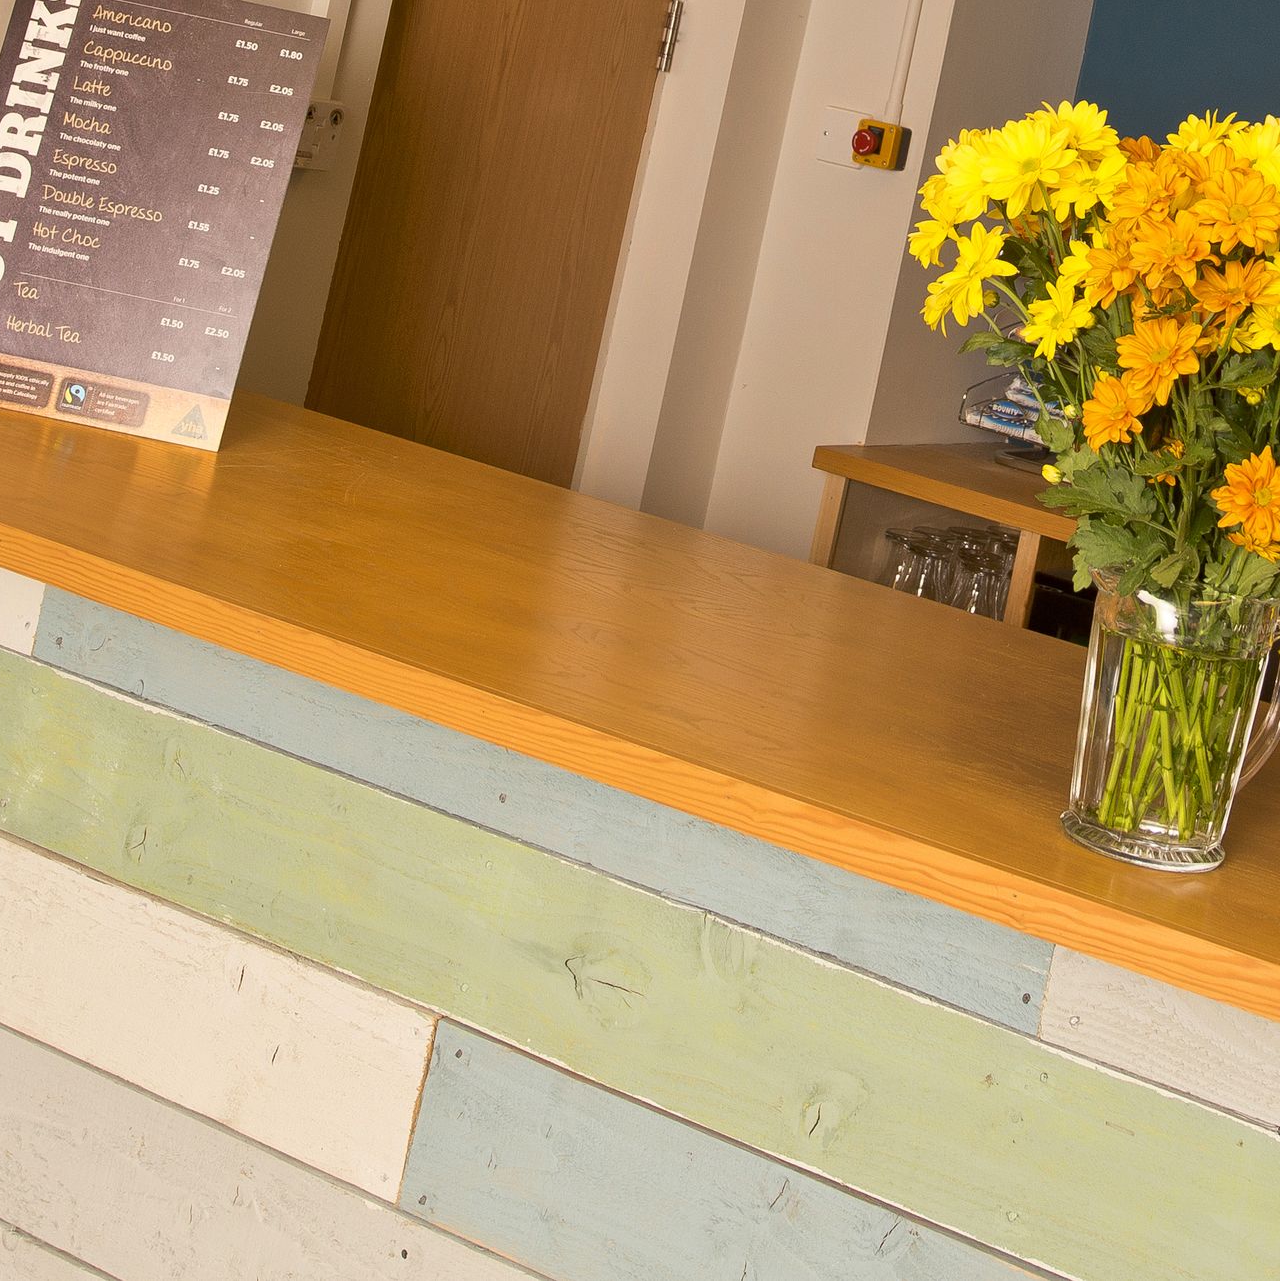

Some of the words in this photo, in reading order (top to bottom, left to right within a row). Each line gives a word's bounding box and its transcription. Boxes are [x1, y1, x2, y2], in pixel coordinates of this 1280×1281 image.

[92, 4, 172, 33] Americano
[235, 39, 259, 51] £1.50
[280, 49, 303, 61] £1.80
[92, 25, 106, 35] just
[106, 28, 125, 38] want
[124, 32, 146, 42] coffee
[80, 60, 94, 70] The
[93, 63, 116, 75] frothy
[115, 68, 129, 77] one
[83, 40, 173, 71] Cappuccino
[227, 75, 249, 87] £1.75
[270, 84, 294, 96] £2.05
[69, 95, 83, 105] The
[83, 99, 104, 111] milky
[102, 104, 117, 112] one
[73, 76, 112, 97] Latte
[218, 111, 240, 123] £1.75
[260, 120, 284, 132] £2.05
[60, 132, 73, 142] The
[72, 135, 107, 150] chocolaty
[107, 142, 121, 152] one
[63, 111, 112, 135] Mocha
[208, 147, 230, 160] £1.75
[250, 156, 275, 169] £2.05
[49, 168, 63, 179] The
[62, 171, 86, 184] potent
[85, 177, 100, 186] one
[53, 148, 117, 174] Espresso
[197, 183, 220, 196] £1.25
[39, 205, 53, 215] The
[52, 208, 73, 220] really
[72, 212, 97, 225] potent
[96, 218, 110, 227] one
[42, 184, 95, 209] Double
[98, 196, 163, 222] Espresso
[188, 220, 210, 233] £1.55
[28, 242, 42, 252] The
[41, 245, 76, 259] indulgent
[75, 253, 90, 262] one
[32, 221, 59, 239] Hot
[61, 228, 101, 249] Choc
[178, 257, 200, 269] £1.75
[221, 266, 246, 279] £2.05
[14, 281, 40, 300] Tea
[160, 317, 184, 330] £1.50
[205, 326, 230, 339] £2.50
[6, 315, 53, 338] Herbal
[55, 325, 82, 344] Tea
[151, 350, 175, 363] £1.50
[992, 404, 1019, 416] BOUNTY
[180, 421, 203, 436] yha
